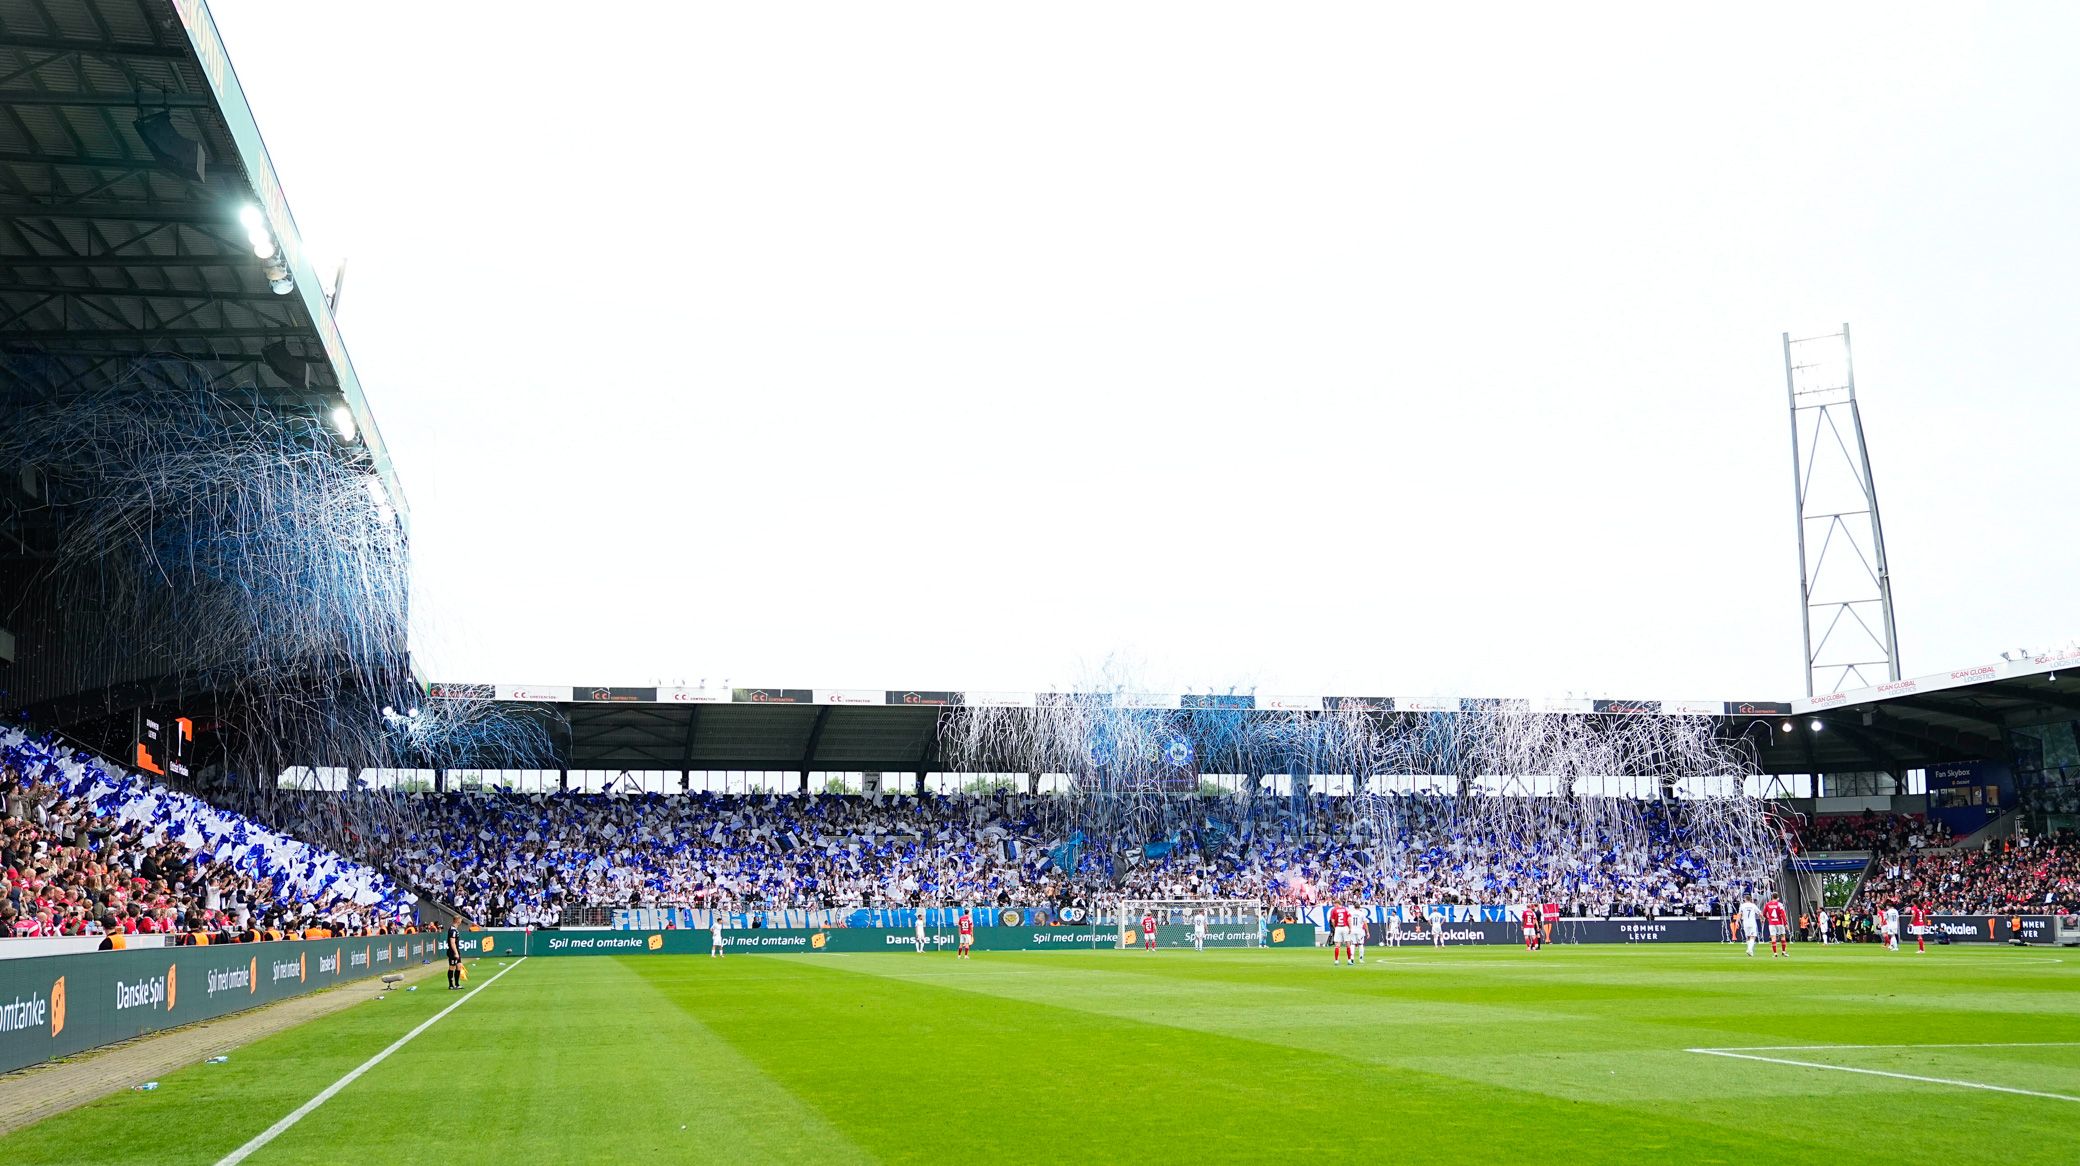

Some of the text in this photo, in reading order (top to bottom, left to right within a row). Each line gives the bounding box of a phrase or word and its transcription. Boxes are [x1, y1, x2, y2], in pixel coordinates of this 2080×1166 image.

[1935, 769, 1971, 778] Fan Skybox
[1337, 913, 1344, 923] 2
[1527, 915, 1532, 923] 6
[1746, 909, 1751, 919] 7
[1771, 908, 1777, 919] 4
[1352, 916, 1358, 926] 11
[2006, 920, 2045, 929] DMMEN
[1620, 924, 1666, 932] DRØMMEN
[886, 934, 954, 946] Danse Spil
[1033, 932, 1118, 945] Spil med omtanke
[1442, 928, 1484, 941] okalen
[458, 939, 477, 951] Spil
[549, 937, 642, 950] Spil med omtanke
[721, 935, 806, 948] pil med omtanke
[207, 965, 248, 998] Spil med omtanke
[117, 975, 165, 1010] Danske Spil
